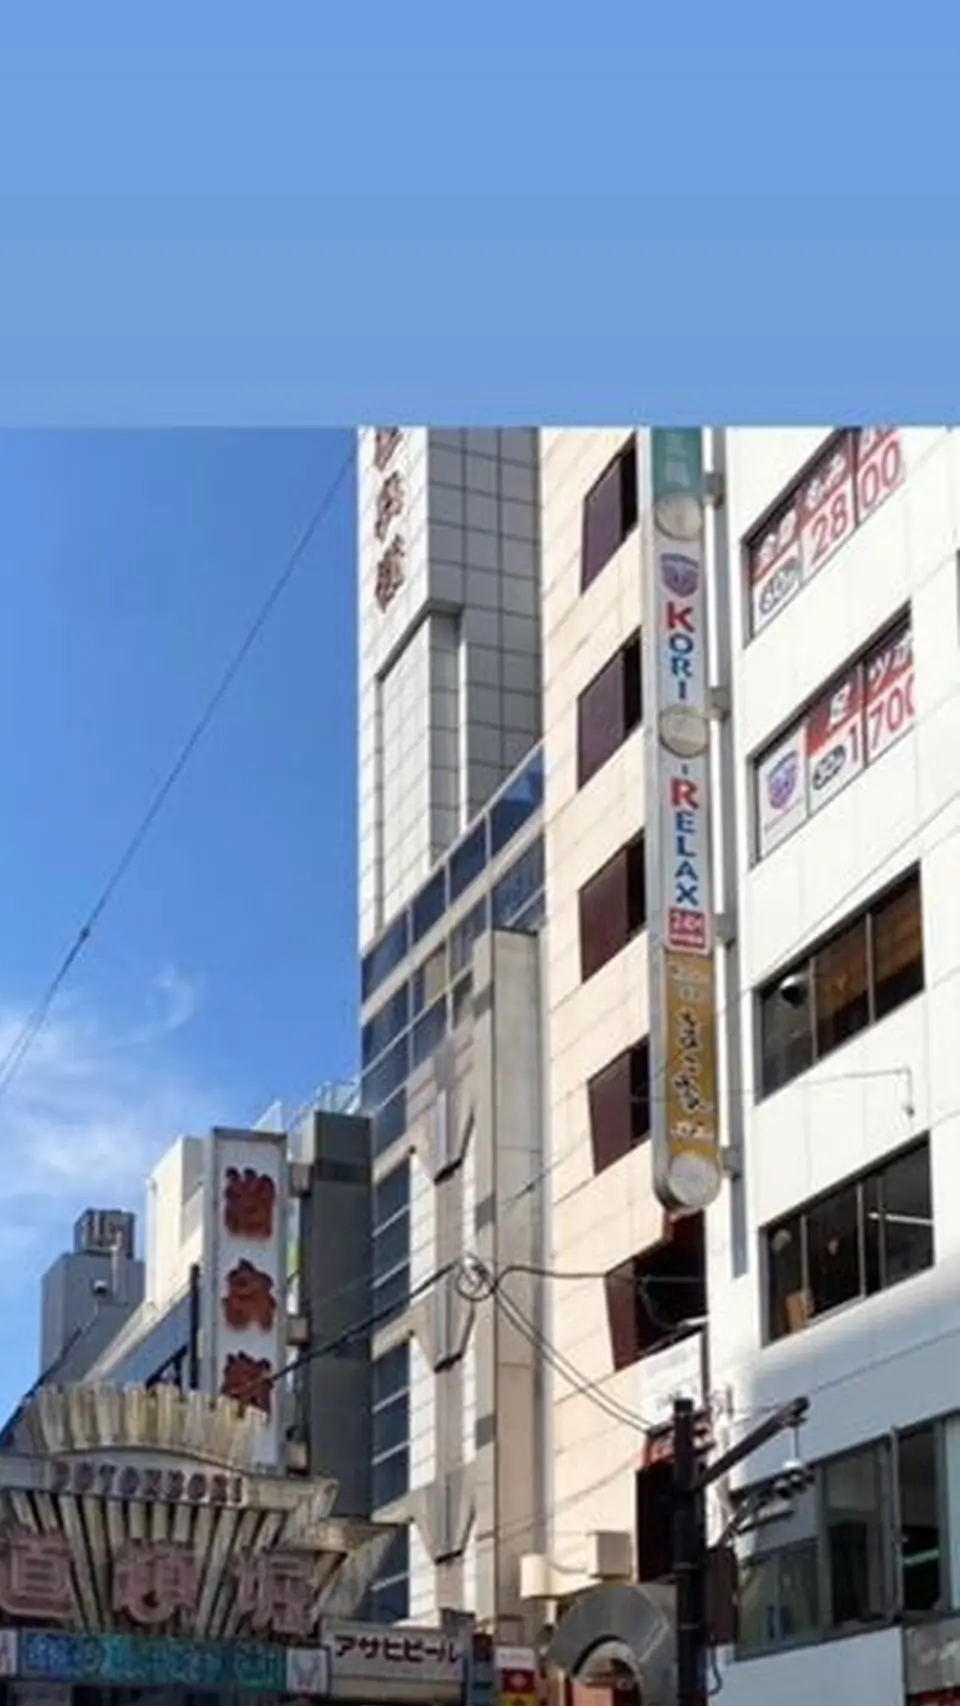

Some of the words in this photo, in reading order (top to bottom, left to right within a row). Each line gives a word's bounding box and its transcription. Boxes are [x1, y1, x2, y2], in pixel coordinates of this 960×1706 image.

[334, 1633, 462, 1664] アサヒビール
